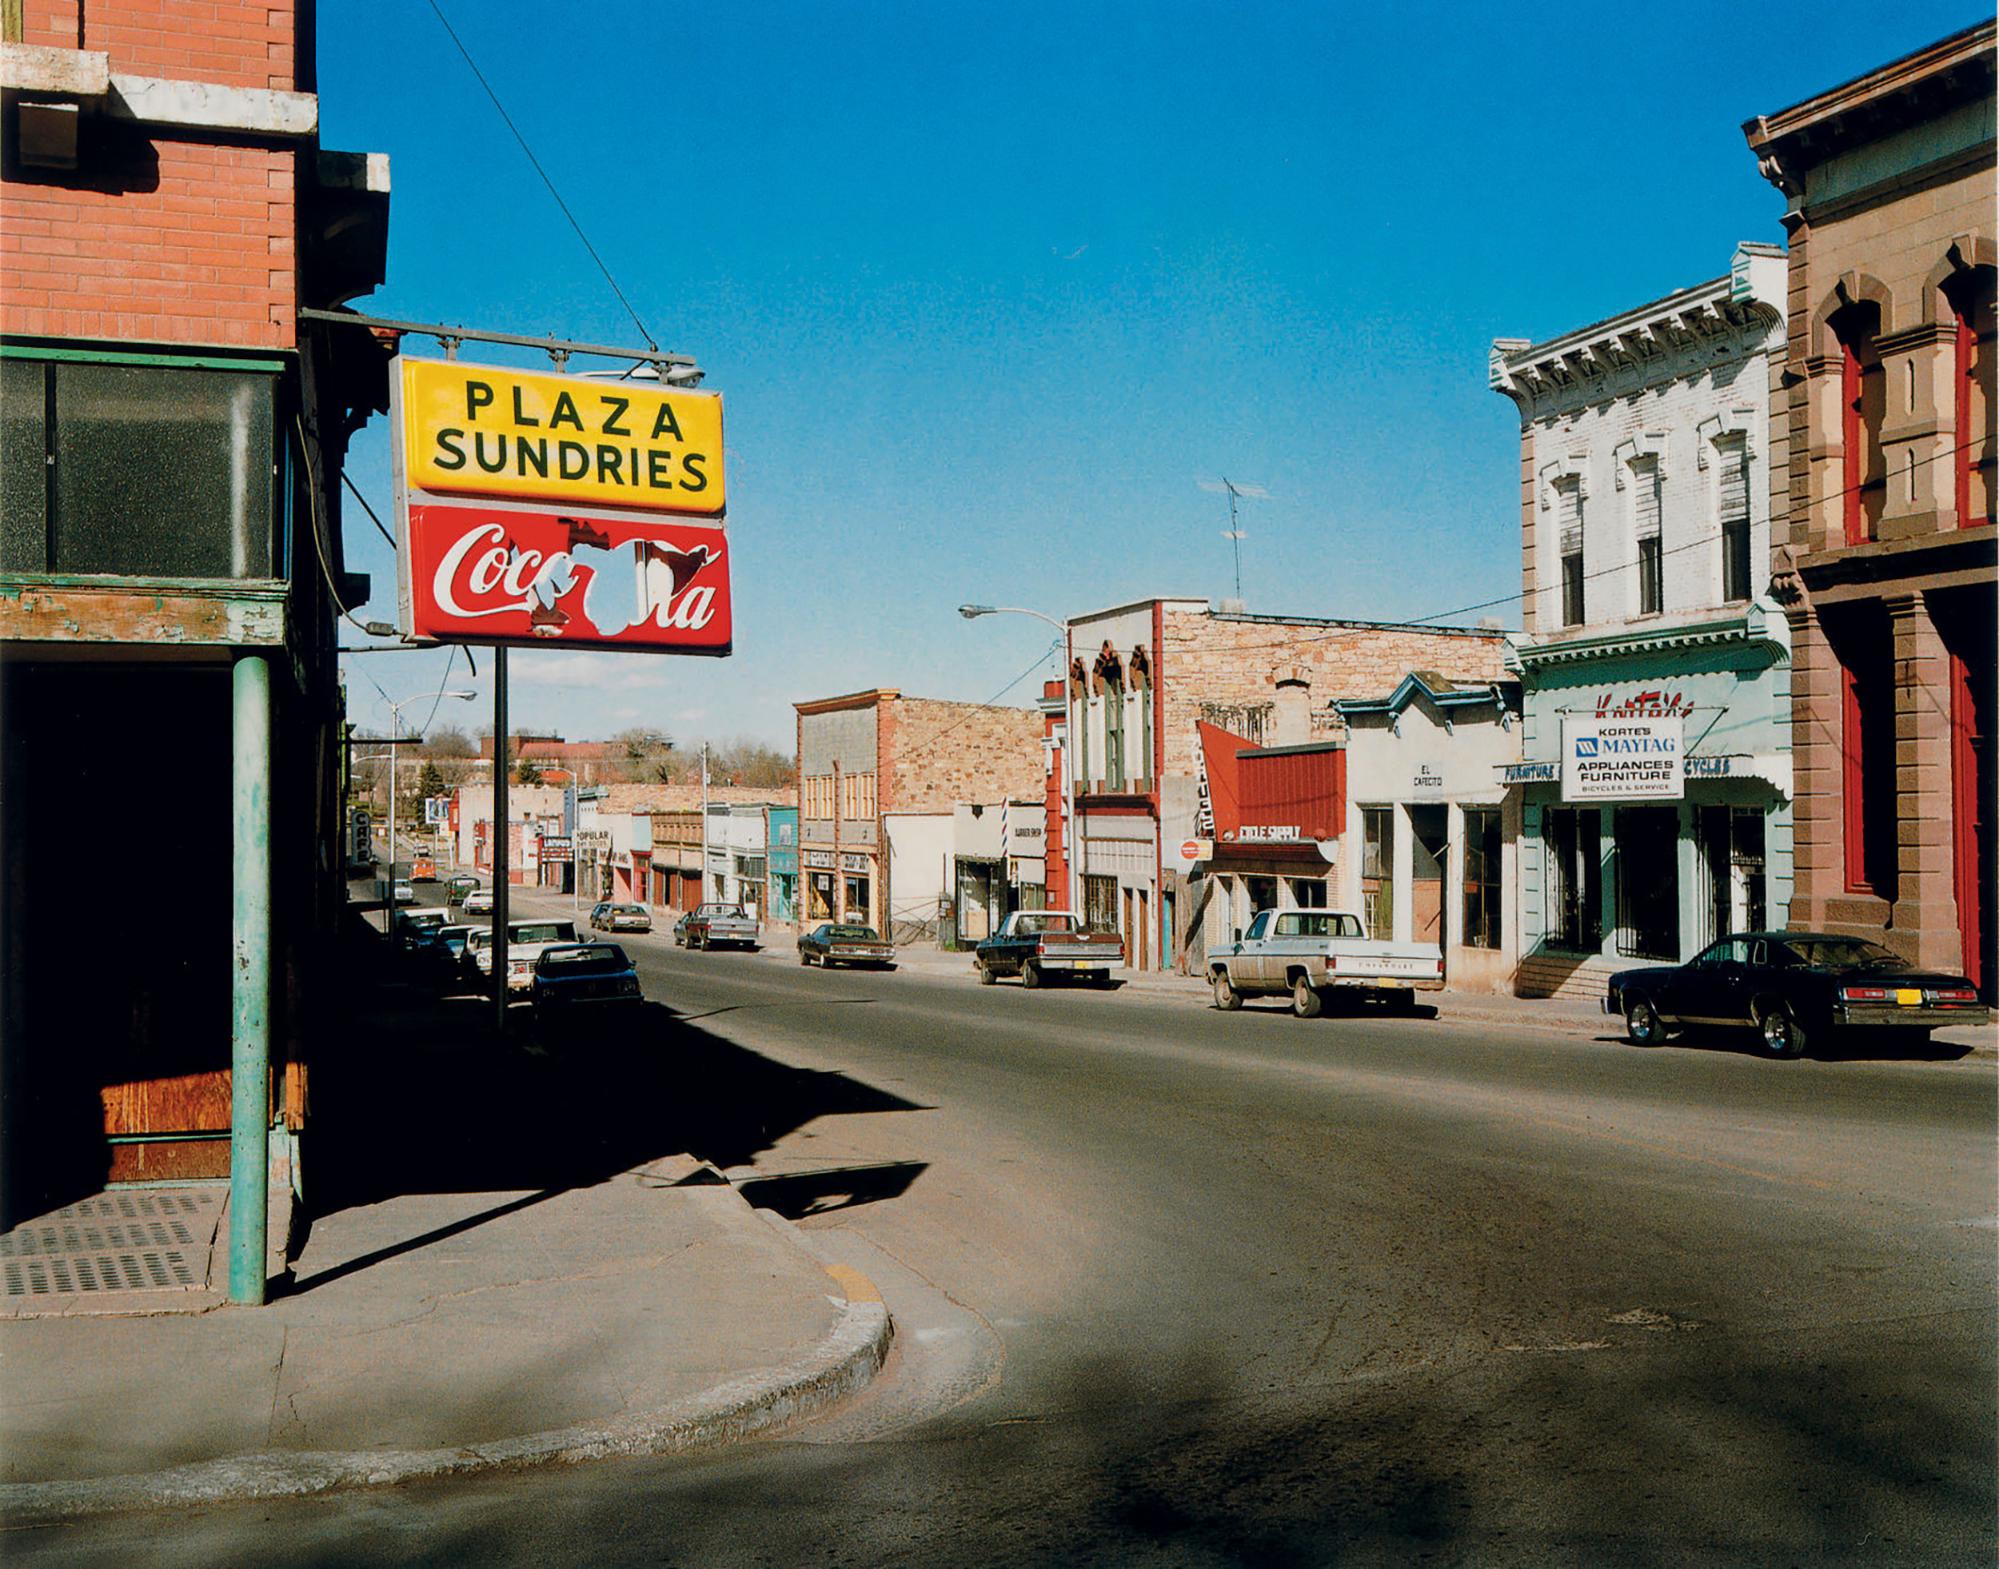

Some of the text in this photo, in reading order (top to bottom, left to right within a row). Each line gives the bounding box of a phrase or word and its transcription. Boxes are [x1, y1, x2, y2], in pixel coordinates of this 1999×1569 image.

[465, 380, 684, 442] PLAZA
[433, 428, 707, 492] SUNDRIES
[1602, 737, 1675, 753] MAYTAG
[1421, 765, 1430, 774] EL
[1505, 764, 1554, 781] FURNITURE
[1577, 760, 1674, 771] APPLIANCES
[1580, 771, 1671, 781] FURNITURE
[355, 811, 369, 862] CAFE
